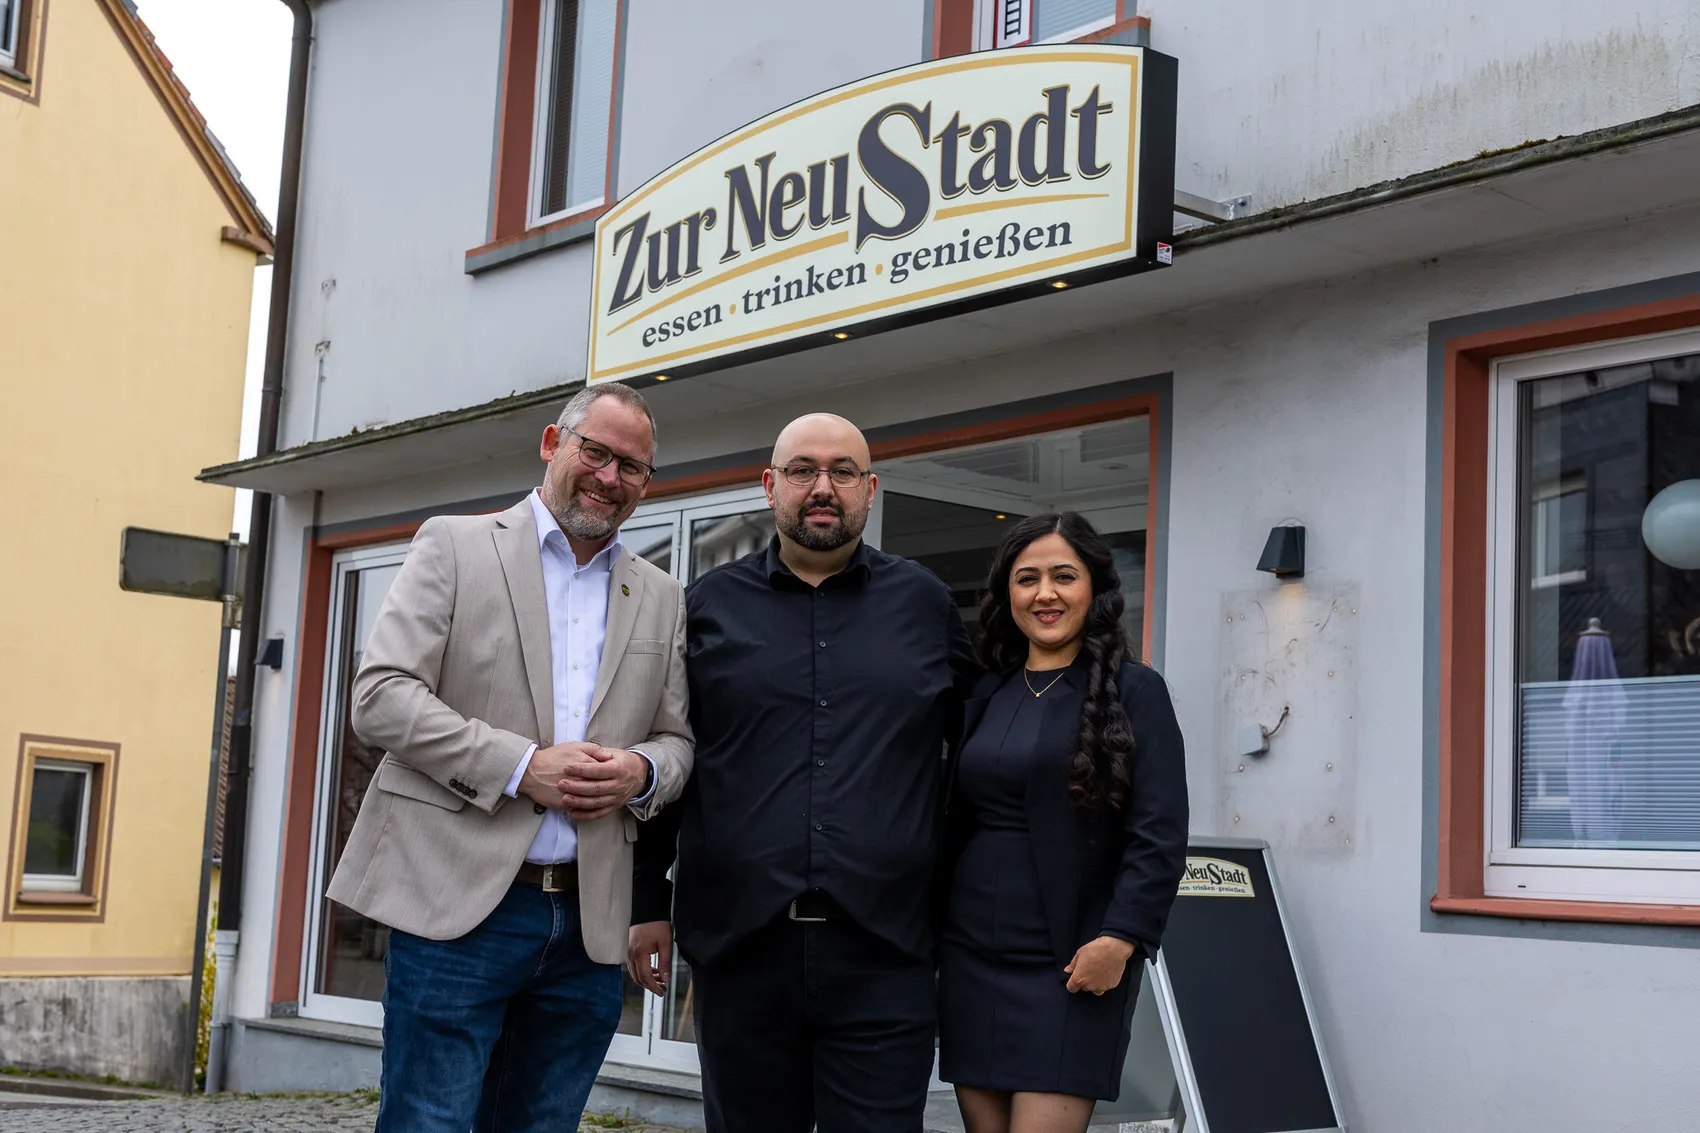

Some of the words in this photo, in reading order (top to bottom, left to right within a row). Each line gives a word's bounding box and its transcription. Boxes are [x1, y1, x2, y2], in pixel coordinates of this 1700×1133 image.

[607, 206, 717, 315] Zur
[719, 83, 1113, 263] NeuStadt
[641, 304, 723, 348] essen
[742, 261, 867, 314] trinken
[890, 214, 1073, 284] genießen
[1186, 863, 1248, 885] NeuStadt
